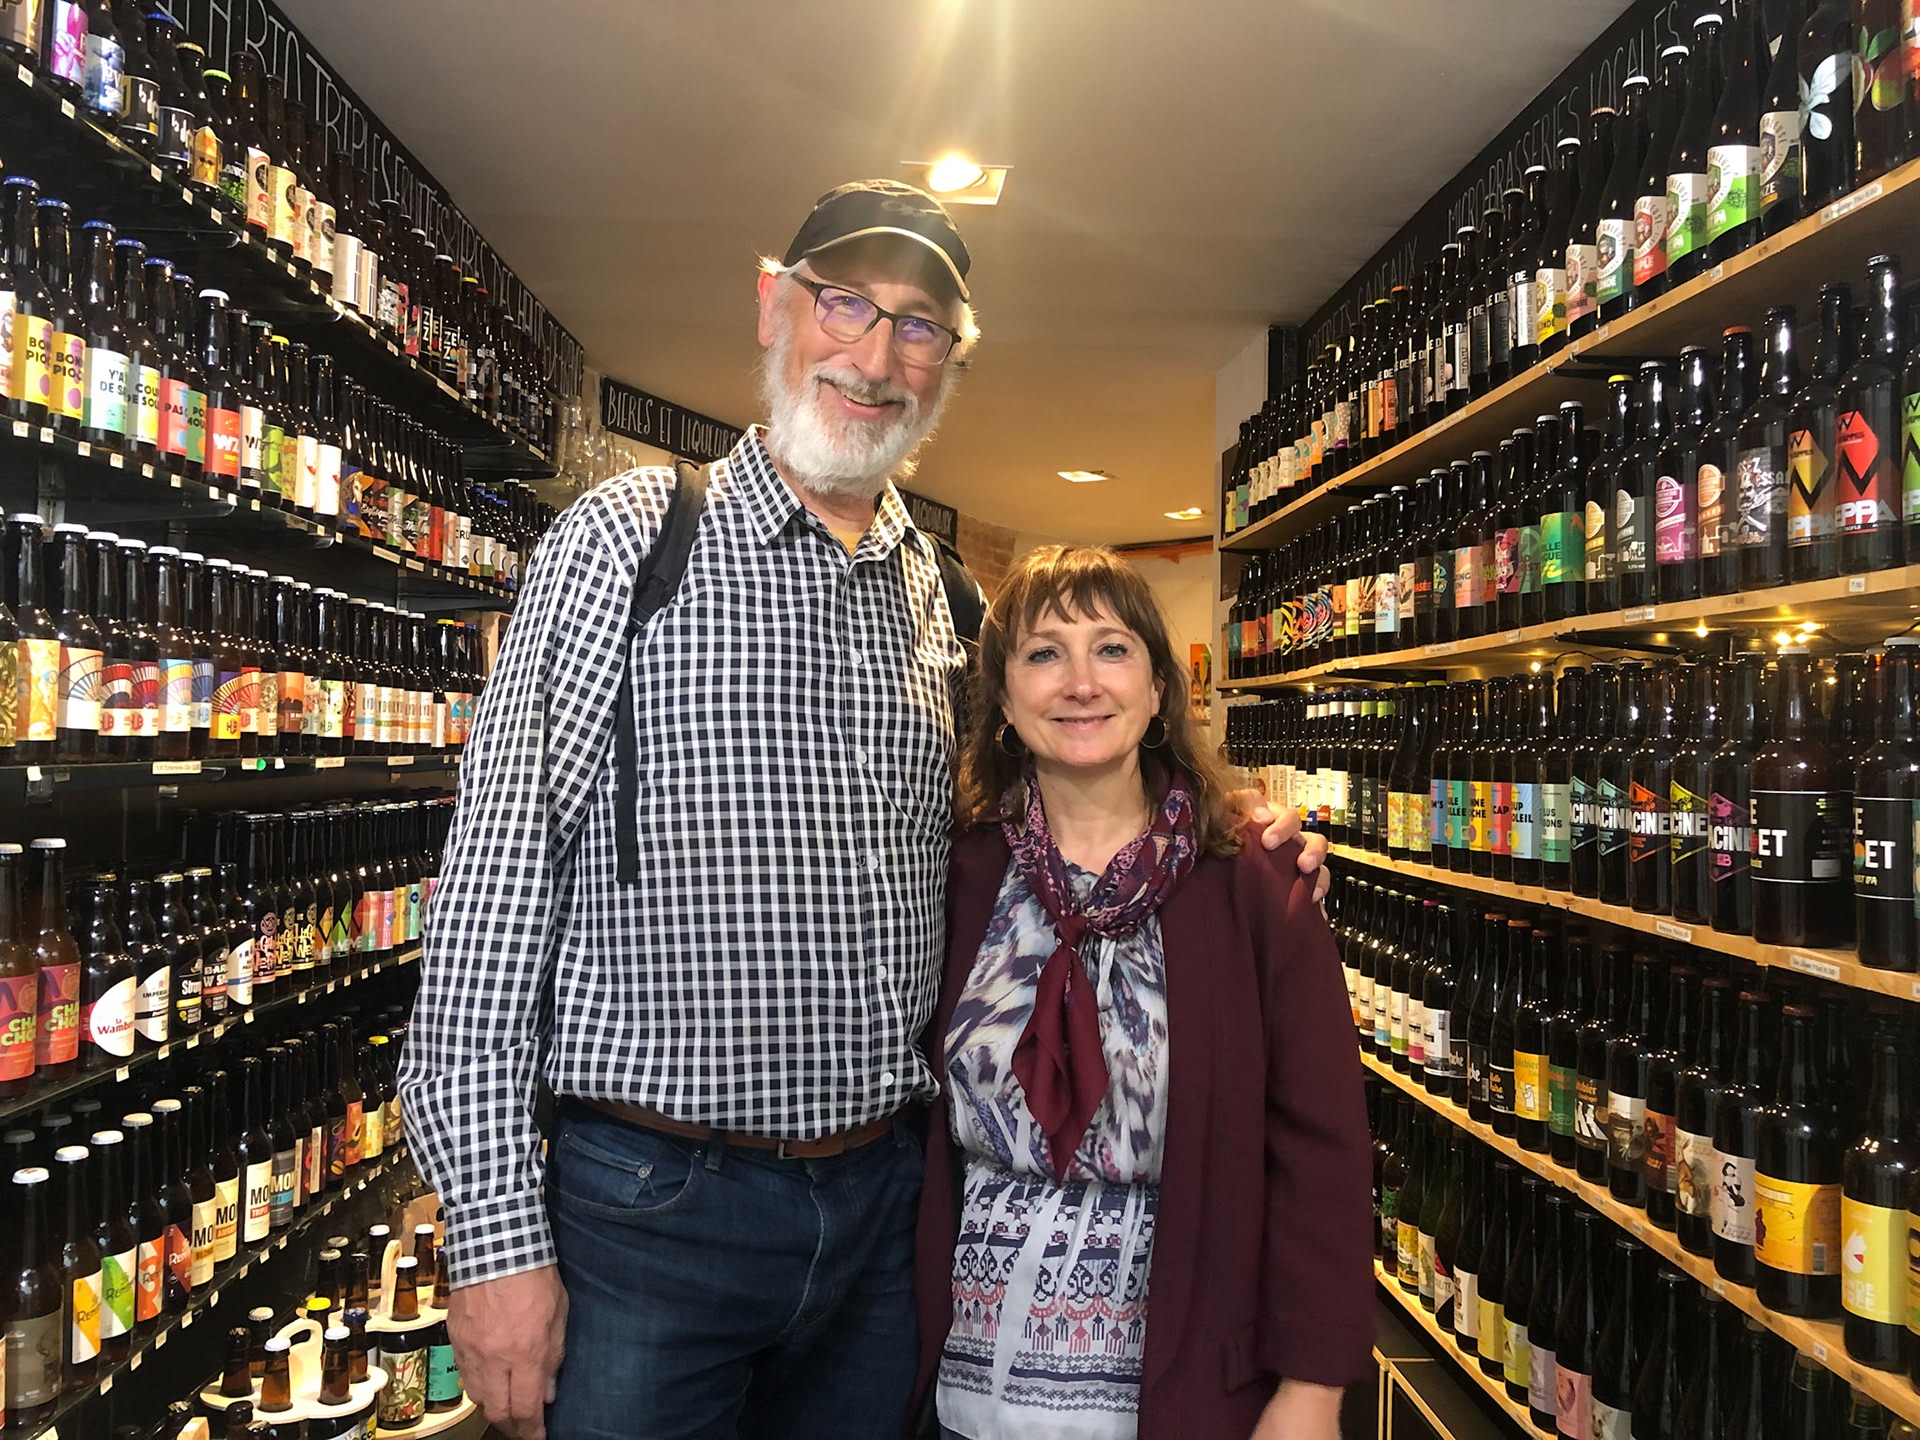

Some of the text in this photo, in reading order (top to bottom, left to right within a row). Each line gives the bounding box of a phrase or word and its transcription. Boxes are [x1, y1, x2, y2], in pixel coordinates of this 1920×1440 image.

[1589, 0, 1682, 116] LOCALES
[1358, 235, 1420, 322] CADEAUX
[1495, 291, 1507, 302] DE
[100, 380, 114, 392] DE
[135, 382, 158, 396] COU
[141, 395, 158, 410] SOL
[163, 402, 186, 415] PAS
[660, 406, 674, 445] ET
[680, 413, 737, 460] LIQUEURS
[1834, 499, 1898, 530] EPPA
[271, 1173, 294, 1192] MO
[250, 1185, 269, 1206] MO
[216, 1203, 236, 1225] MO
[194, 1225, 214, 1248] MO
